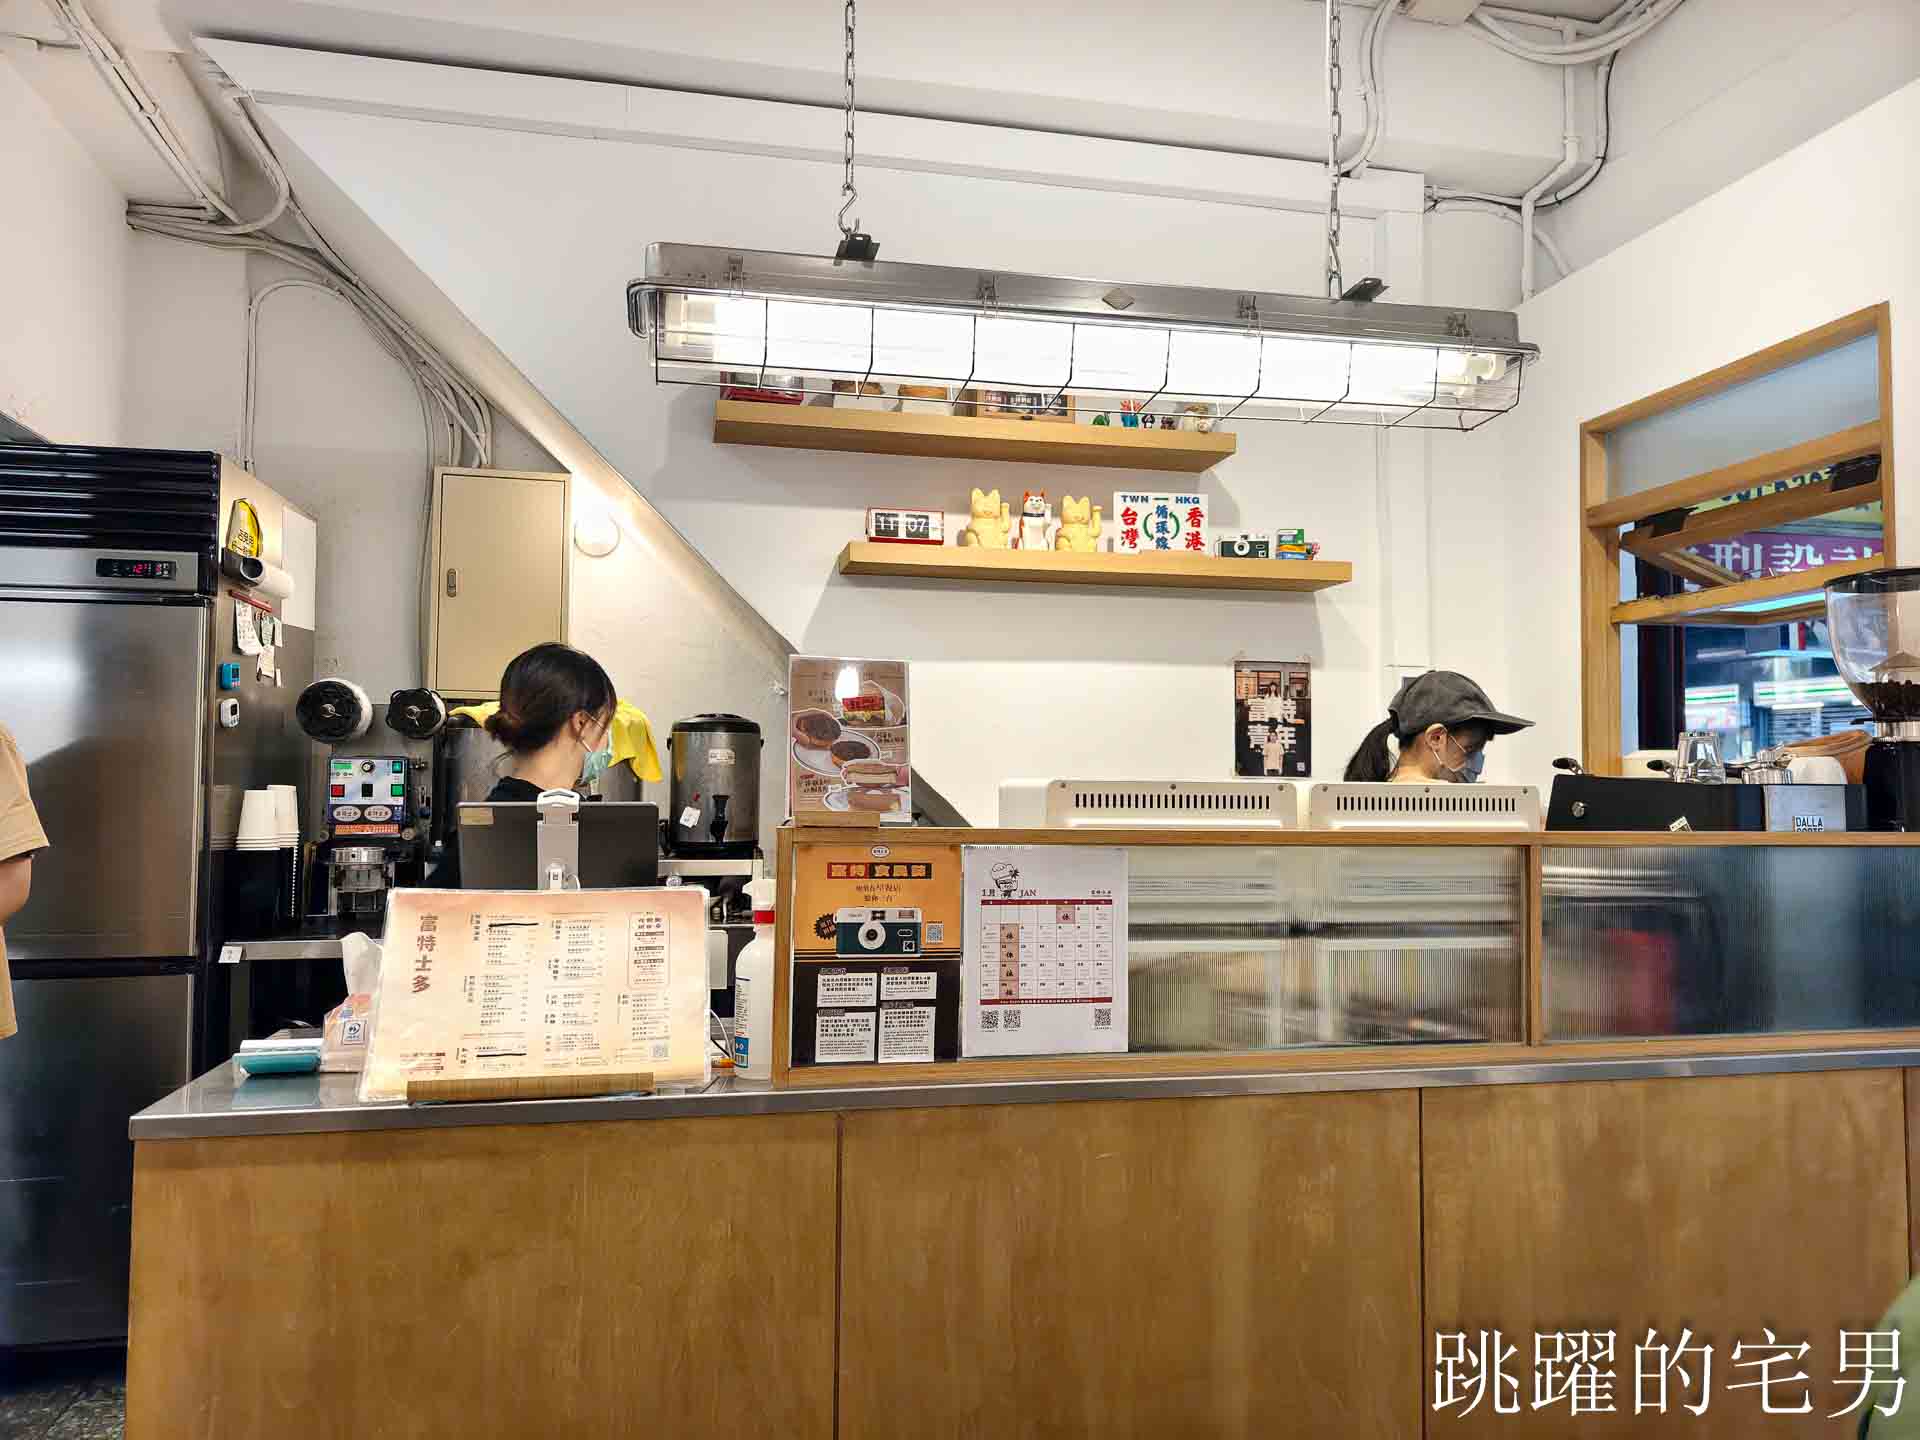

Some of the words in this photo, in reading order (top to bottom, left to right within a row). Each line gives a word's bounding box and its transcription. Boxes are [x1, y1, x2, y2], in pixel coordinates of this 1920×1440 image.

[1120, 495, 1149, 503] TWN
[1175, 496, 1200, 504] HKG
[907, 518, 927, 532] 07
[1120, 506, 1138, 549] 台灣
[1155, 504, 1170, 550] 循環線
[1185, 507, 1205, 551] 香港
[1795, 816, 1823, 827] DALLA
[1019, 889, 1037, 898] JAN
[412, 912, 438, 993] 富特士多
